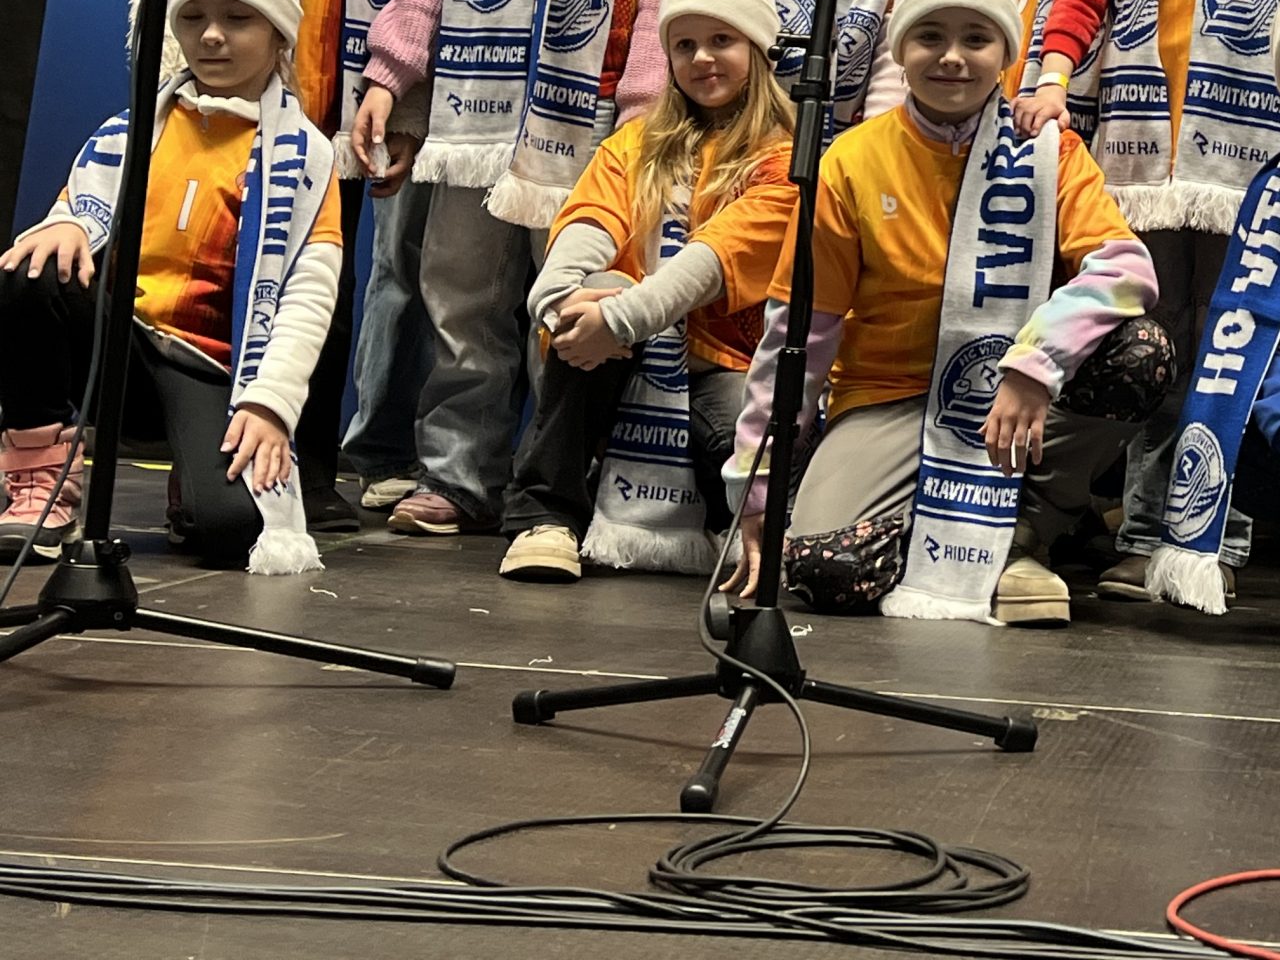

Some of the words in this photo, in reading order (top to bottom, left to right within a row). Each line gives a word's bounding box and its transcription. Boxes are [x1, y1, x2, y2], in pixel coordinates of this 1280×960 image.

[464, 99, 513, 114] RIDERA
[1212, 141, 1269, 165] RIDERA
[177, 179, 199, 231] 1
[611, 421, 689, 448] #ZAVITKO
[923, 476, 1018, 508] #ZAVITKOVICE
